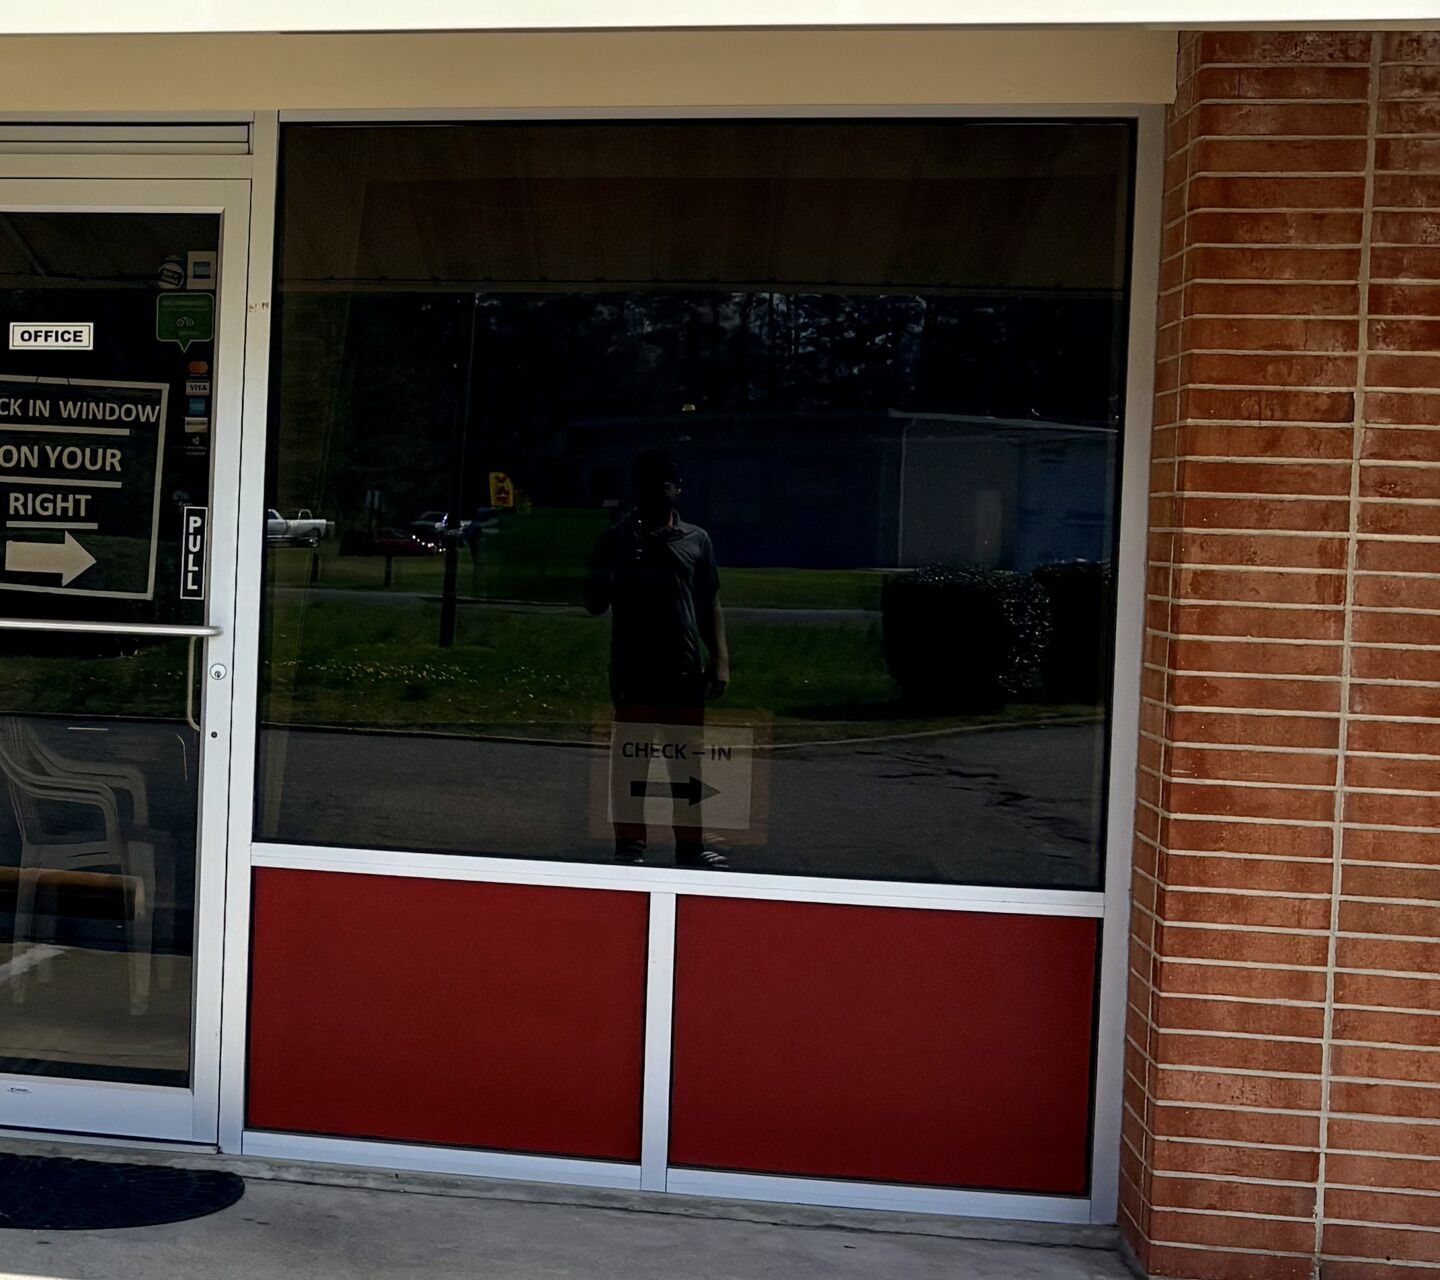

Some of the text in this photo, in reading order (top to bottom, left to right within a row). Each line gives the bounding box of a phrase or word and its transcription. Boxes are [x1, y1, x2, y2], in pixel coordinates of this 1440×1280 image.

[20, 330, 83, 343] OFFICE
[28, 398, 50, 418] IN
[58, 400, 160, 423] WINDOW
[45, 446, 122, 472] YOUR
[8, 492, 92, 518] RIGHT
[186, 516, 202, 590] PULL
[622, 742, 686, 759] CHECK
[711, 746, 732, 761] IN
